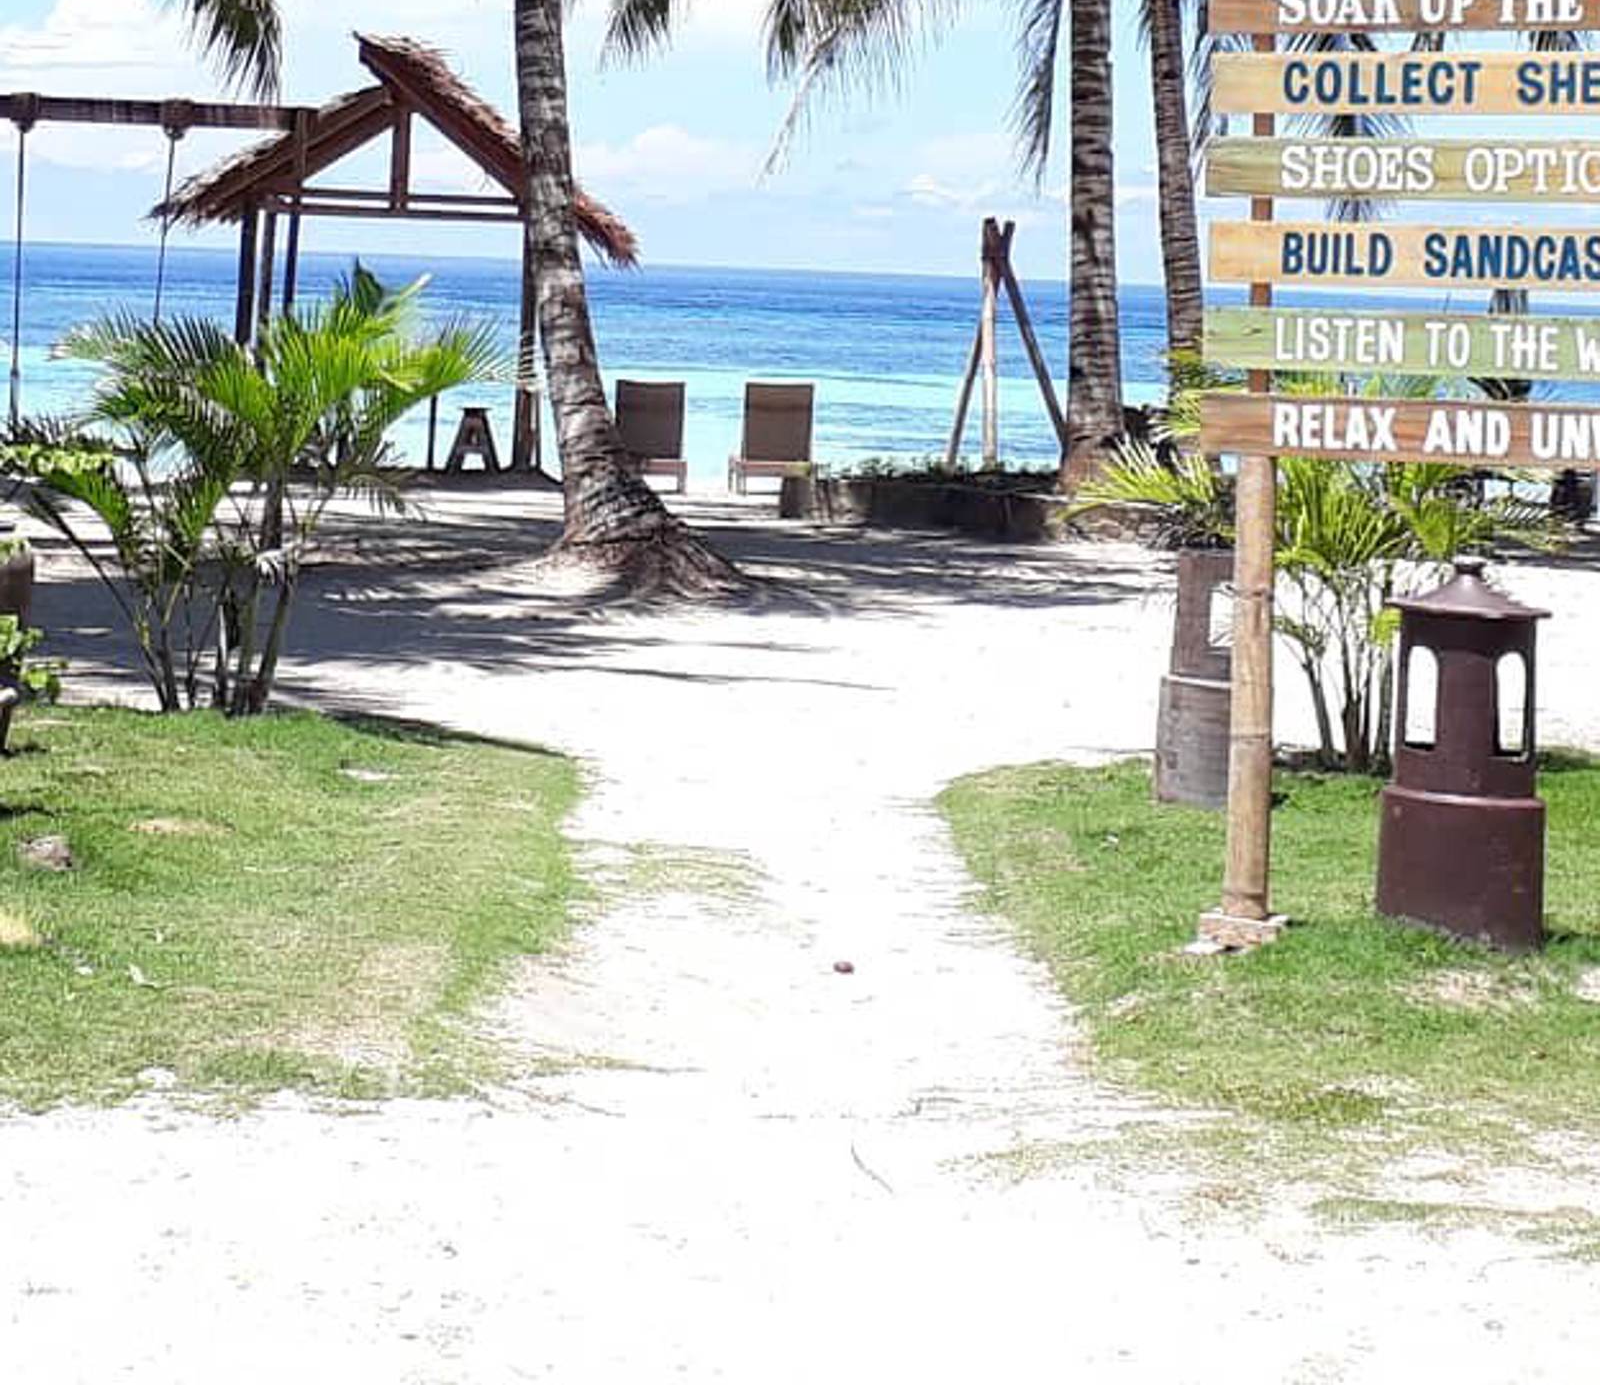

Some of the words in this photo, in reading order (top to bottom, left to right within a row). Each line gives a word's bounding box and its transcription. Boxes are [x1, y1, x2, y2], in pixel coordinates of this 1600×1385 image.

[1283, 60, 1482, 105] COLLECT
[1517, 60, 1600, 106] SHE
[1281, 145, 1435, 192] SHOES
[1282, 232, 1394, 277] BUILD
[1275, 317, 1405, 364] LISTEN
[1425, 321, 1472, 368] TO
[1490, 323, 1560, 371] THE
[1273, 402, 1398, 453] RELAX
[1423, 409, 1511, 456] AND
[1530, 412, 1600, 460] UN
